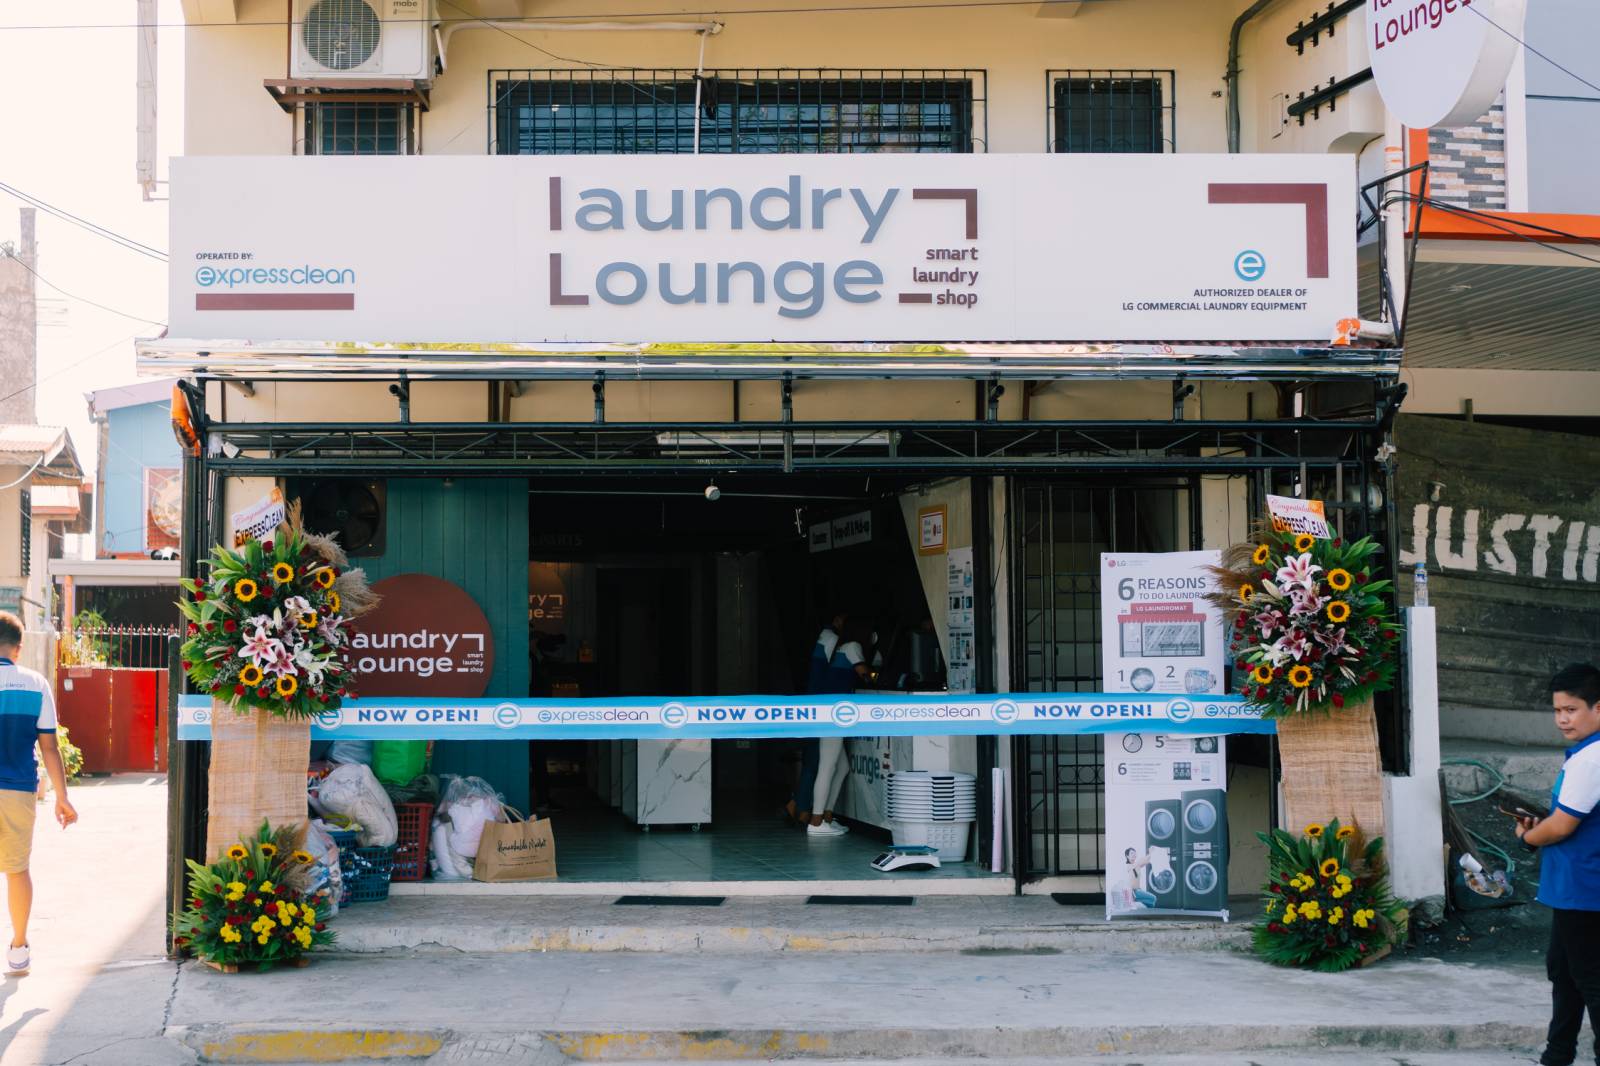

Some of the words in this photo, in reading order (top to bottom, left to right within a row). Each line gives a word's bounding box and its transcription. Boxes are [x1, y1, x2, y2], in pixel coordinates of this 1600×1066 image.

[549, 175, 900, 244] laundry
[926, 246, 979, 260] smart
[196, 264, 355, 288] expressclean
[549, 252, 884, 318] Lounge
[912, 266, 979, 286] laundry
[936, 288, 978, 308] shop
[1194, 288, 1254, 297] AUTHORIZED
[1257, 288, 1292, 297] DEALER
[1294, 288, 1308, 297] OF
[1122, 302, 1134, 311] LG
[1136, 302, 1200, 311] COMMERCIAL
[1203, 302, 1248, 311] LAUNDRY
[1250, 302, 1306, 311] EQUIPMENT
[1118, 578, 1135, 600] 6
[1138, 578, 1206, 589] REASONS
[352, 630, 458, 653] aundry
[1118, 670, 1124, 682] 1
[1166, 666, 1175, 678] 2
[358, 710, 408, 722] NOW
[416, 709, 478, 722] OPEN!
[538, 709, 648, 724] expressclean
[697, 708, 746, 720] NOW
[754, 707, 816, 720] OPEN!
[870, 706, 980, 720] expressclean
[1034, 705, 1081, 717] NOW
[1090, 704, 1152, 716] OPEN!
[1204, 704, 1264, 718] expres
[1155, 736, 1164, 748] 5
[849, 754, 880, 784] ounge
[1118, 763, 1127, 776] 6
